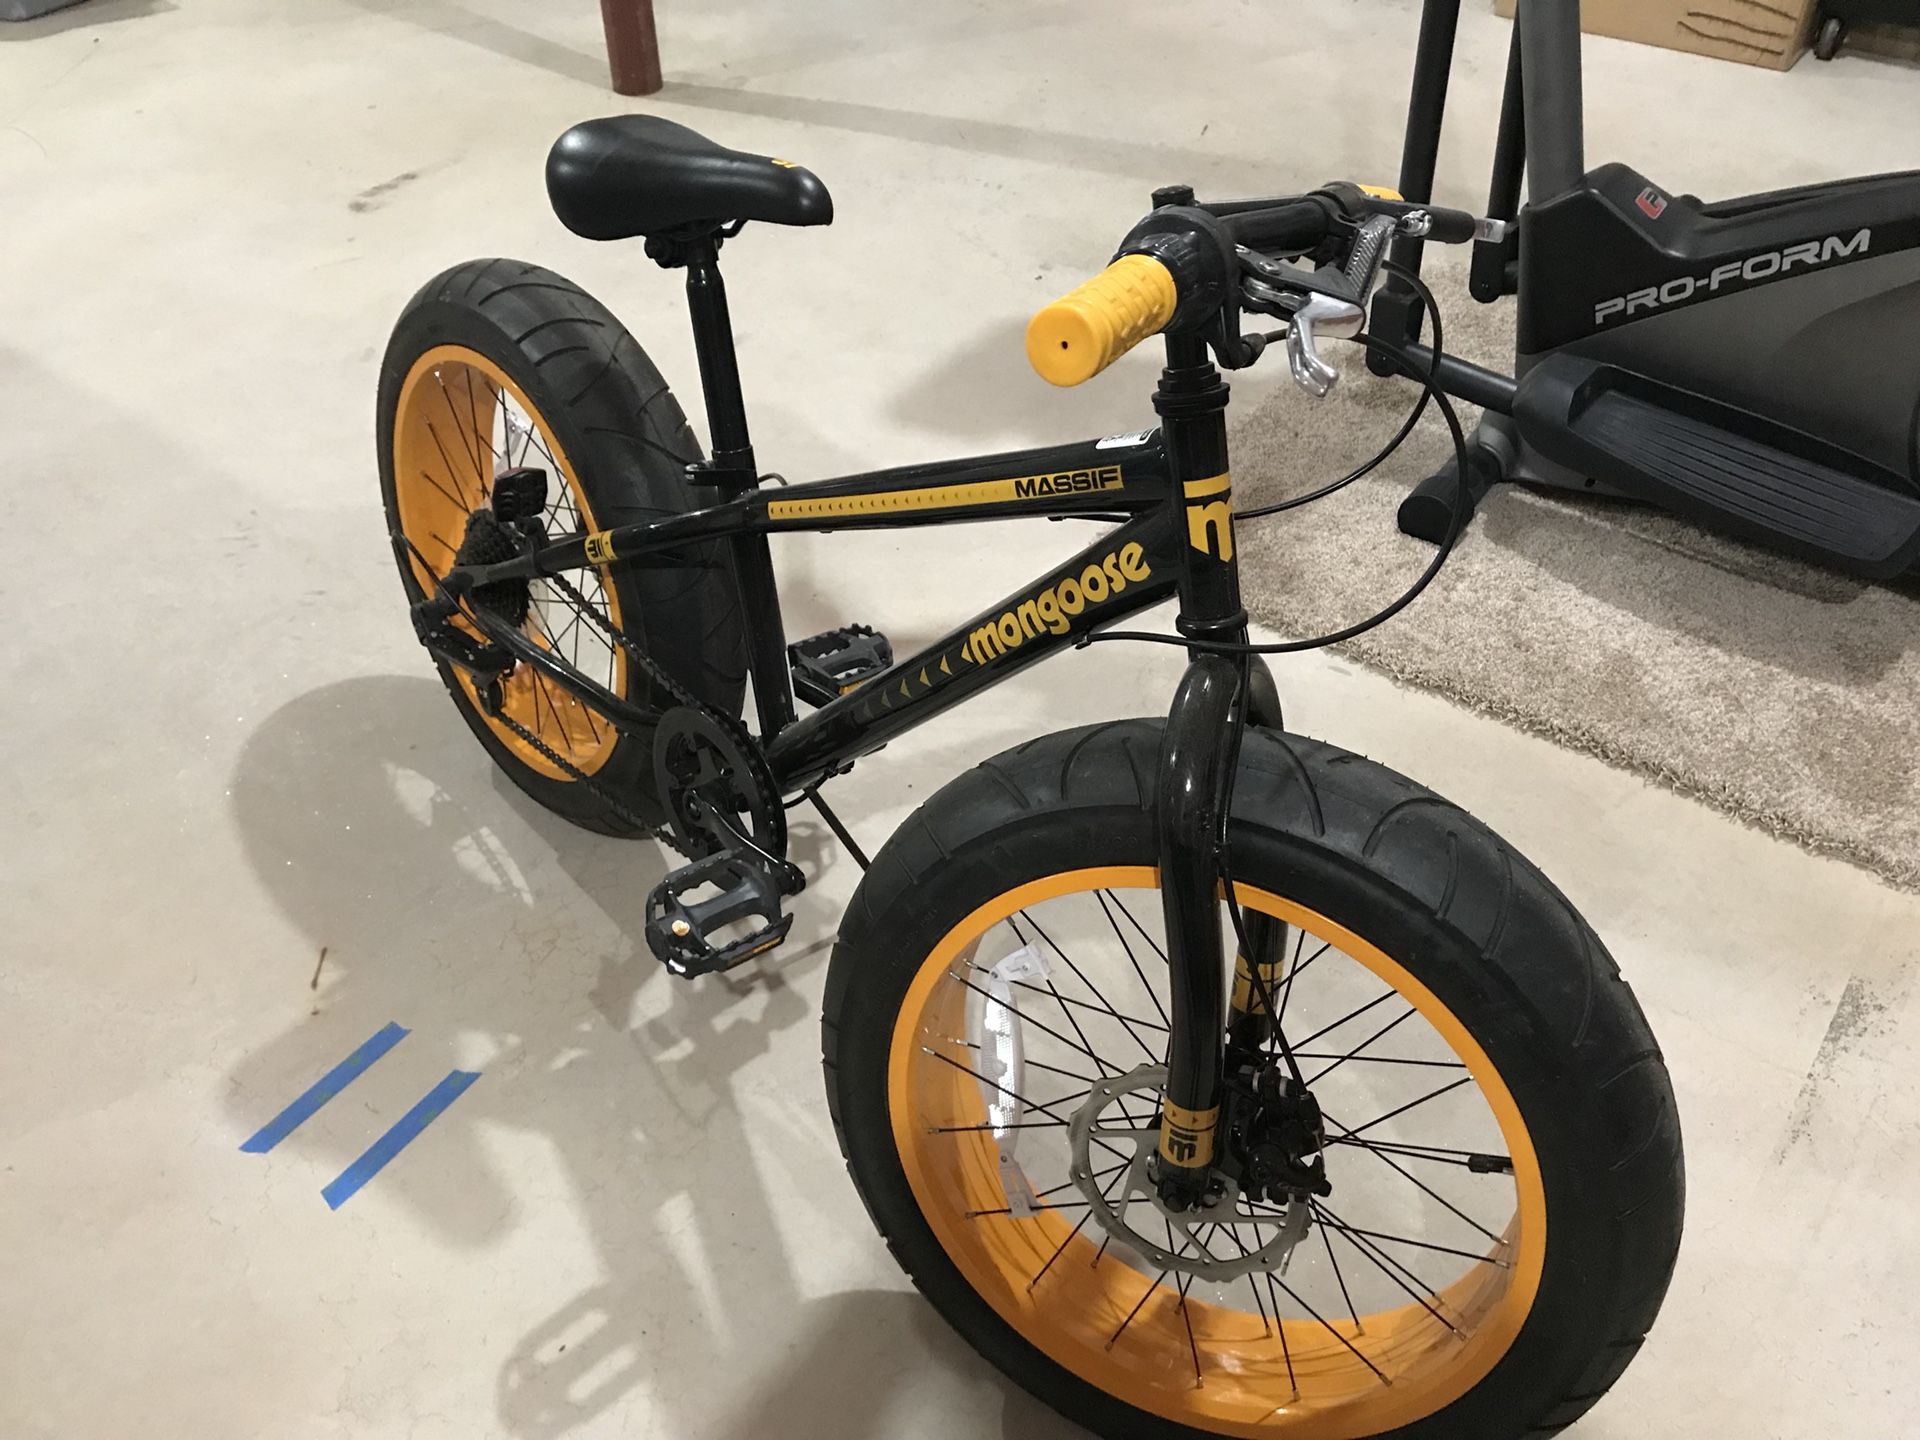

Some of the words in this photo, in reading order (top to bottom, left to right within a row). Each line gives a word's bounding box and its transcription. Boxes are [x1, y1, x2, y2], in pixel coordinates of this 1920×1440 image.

[1594, 228, 1872, 325] PRO-FORM
[1014, 468, 1121, 500] MASSIF
[968, 541, 1152, 665] mongoose
